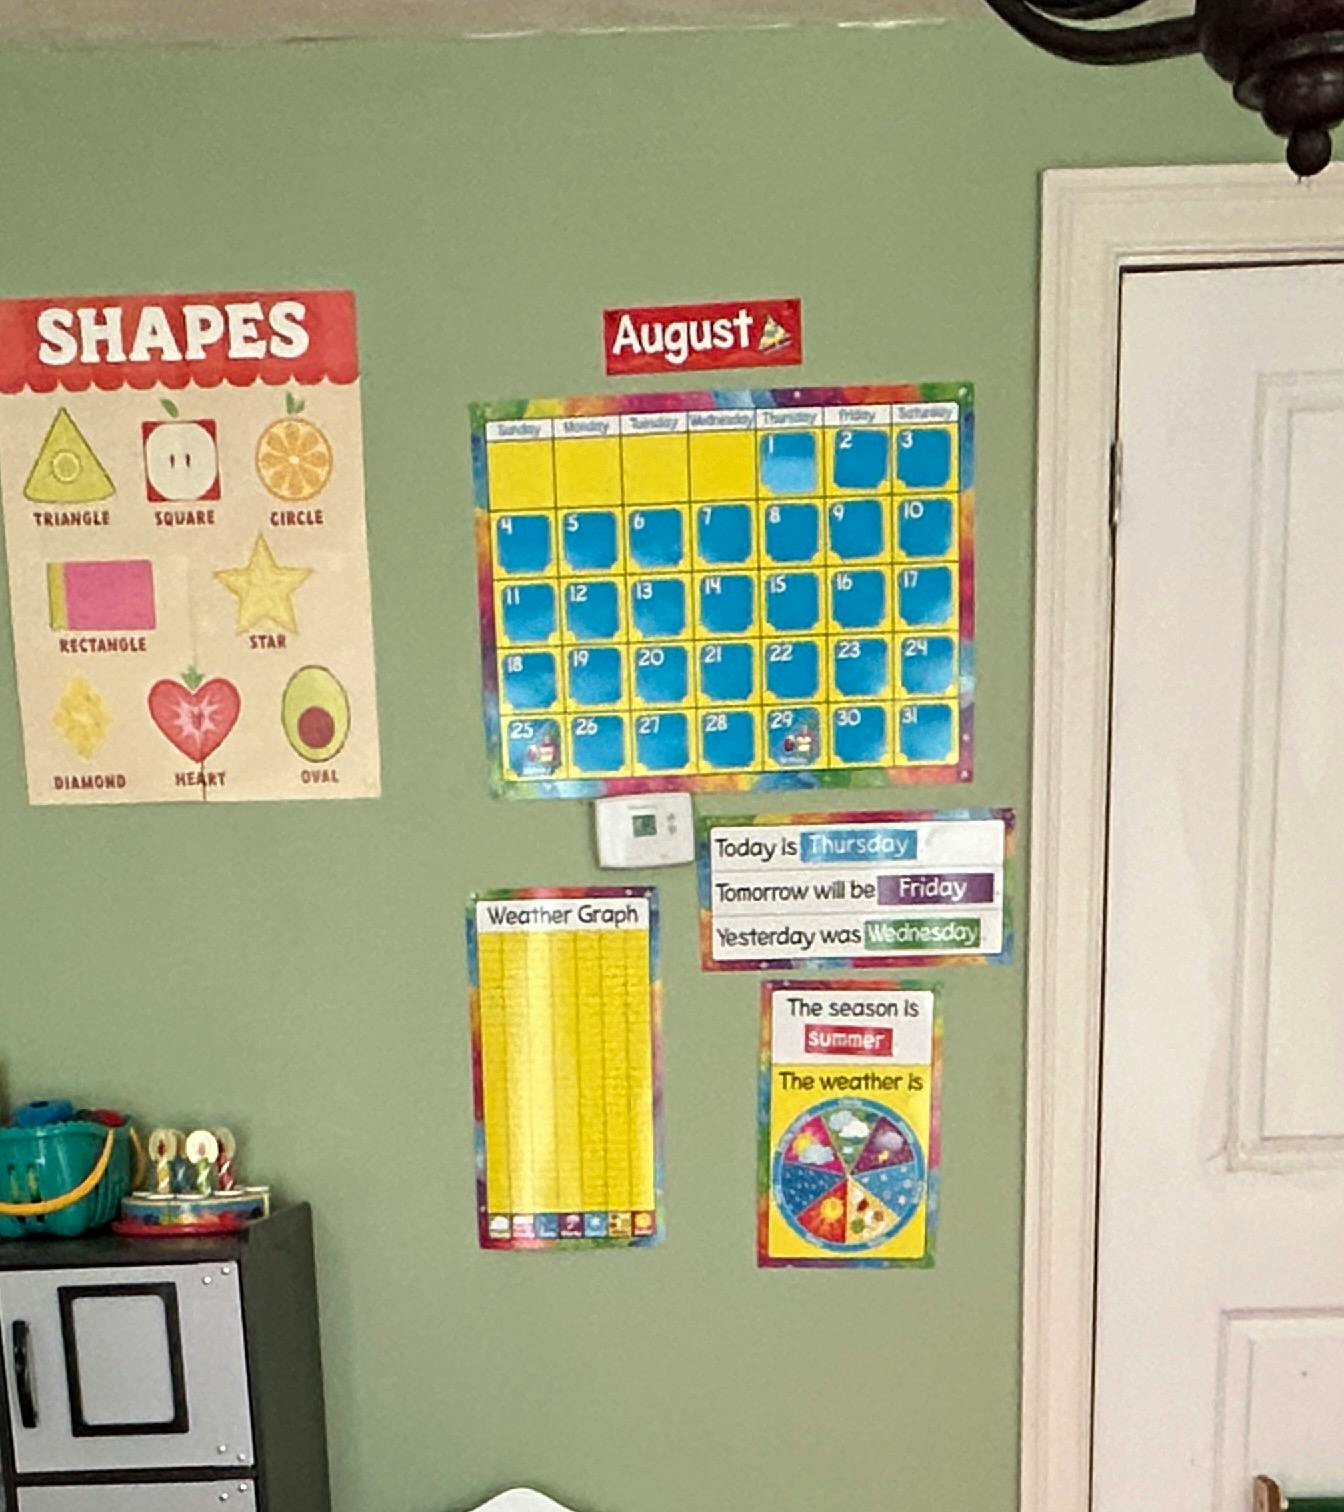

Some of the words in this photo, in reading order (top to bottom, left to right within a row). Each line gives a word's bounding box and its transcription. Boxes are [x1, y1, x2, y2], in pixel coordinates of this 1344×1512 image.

[37, 301, 310, 366] SHAPES
[612, 308, 753, 363] August
[767, 435, 774, 454] 1
[840, 431, 853, 449] 2
[902, 431, 914, 449] 3
[33, 511, 110, 527] TRIANGLE
[155, 509, 216, 528] SQUARE
[270, 509, 324, 527] CIRCLE
[500, 517, 512, 535] 4
[565, 515, 579, 533] 5
[633, 513, 645, 531] 6
[702, 507, 713, 526] 7
[770, 505, 781, 523] 8
[832, 503, 844, 522] 9
[904, 501, 924, 520] 10
[505, 588, 520, 605] 11
[569, 584, 588, 602] 12
[635, 582, 654, 600] 13
[704, 576, 722, 595] 14
[770, 574, 787, 594] 15
[836, 573, 853, 592] 16
[903, 570, 920, 589] 17
[59, 636, 147, 654] RECTANGLE
[249, 633, 287, 650] STAR
[507, 655, 524, 673] 18
[572, 649, 589, 667] 19
[638, 648, 665, 667] 20
[704, 646, 722, 664] 21
[769, 644, 794, 662] 22
[837, 640, 862, 659] 23
[904, 639, 929, 658] 24
[510, 721, 535, 740] 25
[575, 716, 599, 736] 26
[637, 716, 660, 735] 27
[704, 714, 728, 732] 28
[770, 710, 794, 729] 29
[837, 709, 862, 727] 30
[901, 707, 919, 726] 31
[53, 774, 127, 790] DIAMOND
[174, 770, 227, 788] HEART
[300, 768, 339, 785] OVAL
[714, 838, 776, 863] Today
[781, 837, 797, 856] is
[808, 833, 908, 857] Thursday
[714, 882, 809, 902] Tomorrow
[814, 880, 846, 900] will
[850, 879, 876, 899] be
[898, 877, 968, 900] Friday
[487, 906, 572, 925] Weather
[578, 904, 639, 930] Graph
[715, 926, 816, 950] Yesterday
[819, 929, 862, 945] was
[867, 923, 981, 946] Wednesday
[787, 997, 823, 1017] The
[828, 1001, 898, 1017] season
[904, 999, 919, 1018] is
[808, 1030, 885, 1050] summer
[779, 1071, 814, 1091] The
[819, 1071, 903, 1091] weather
[908, 1072, 924, 1092] is
